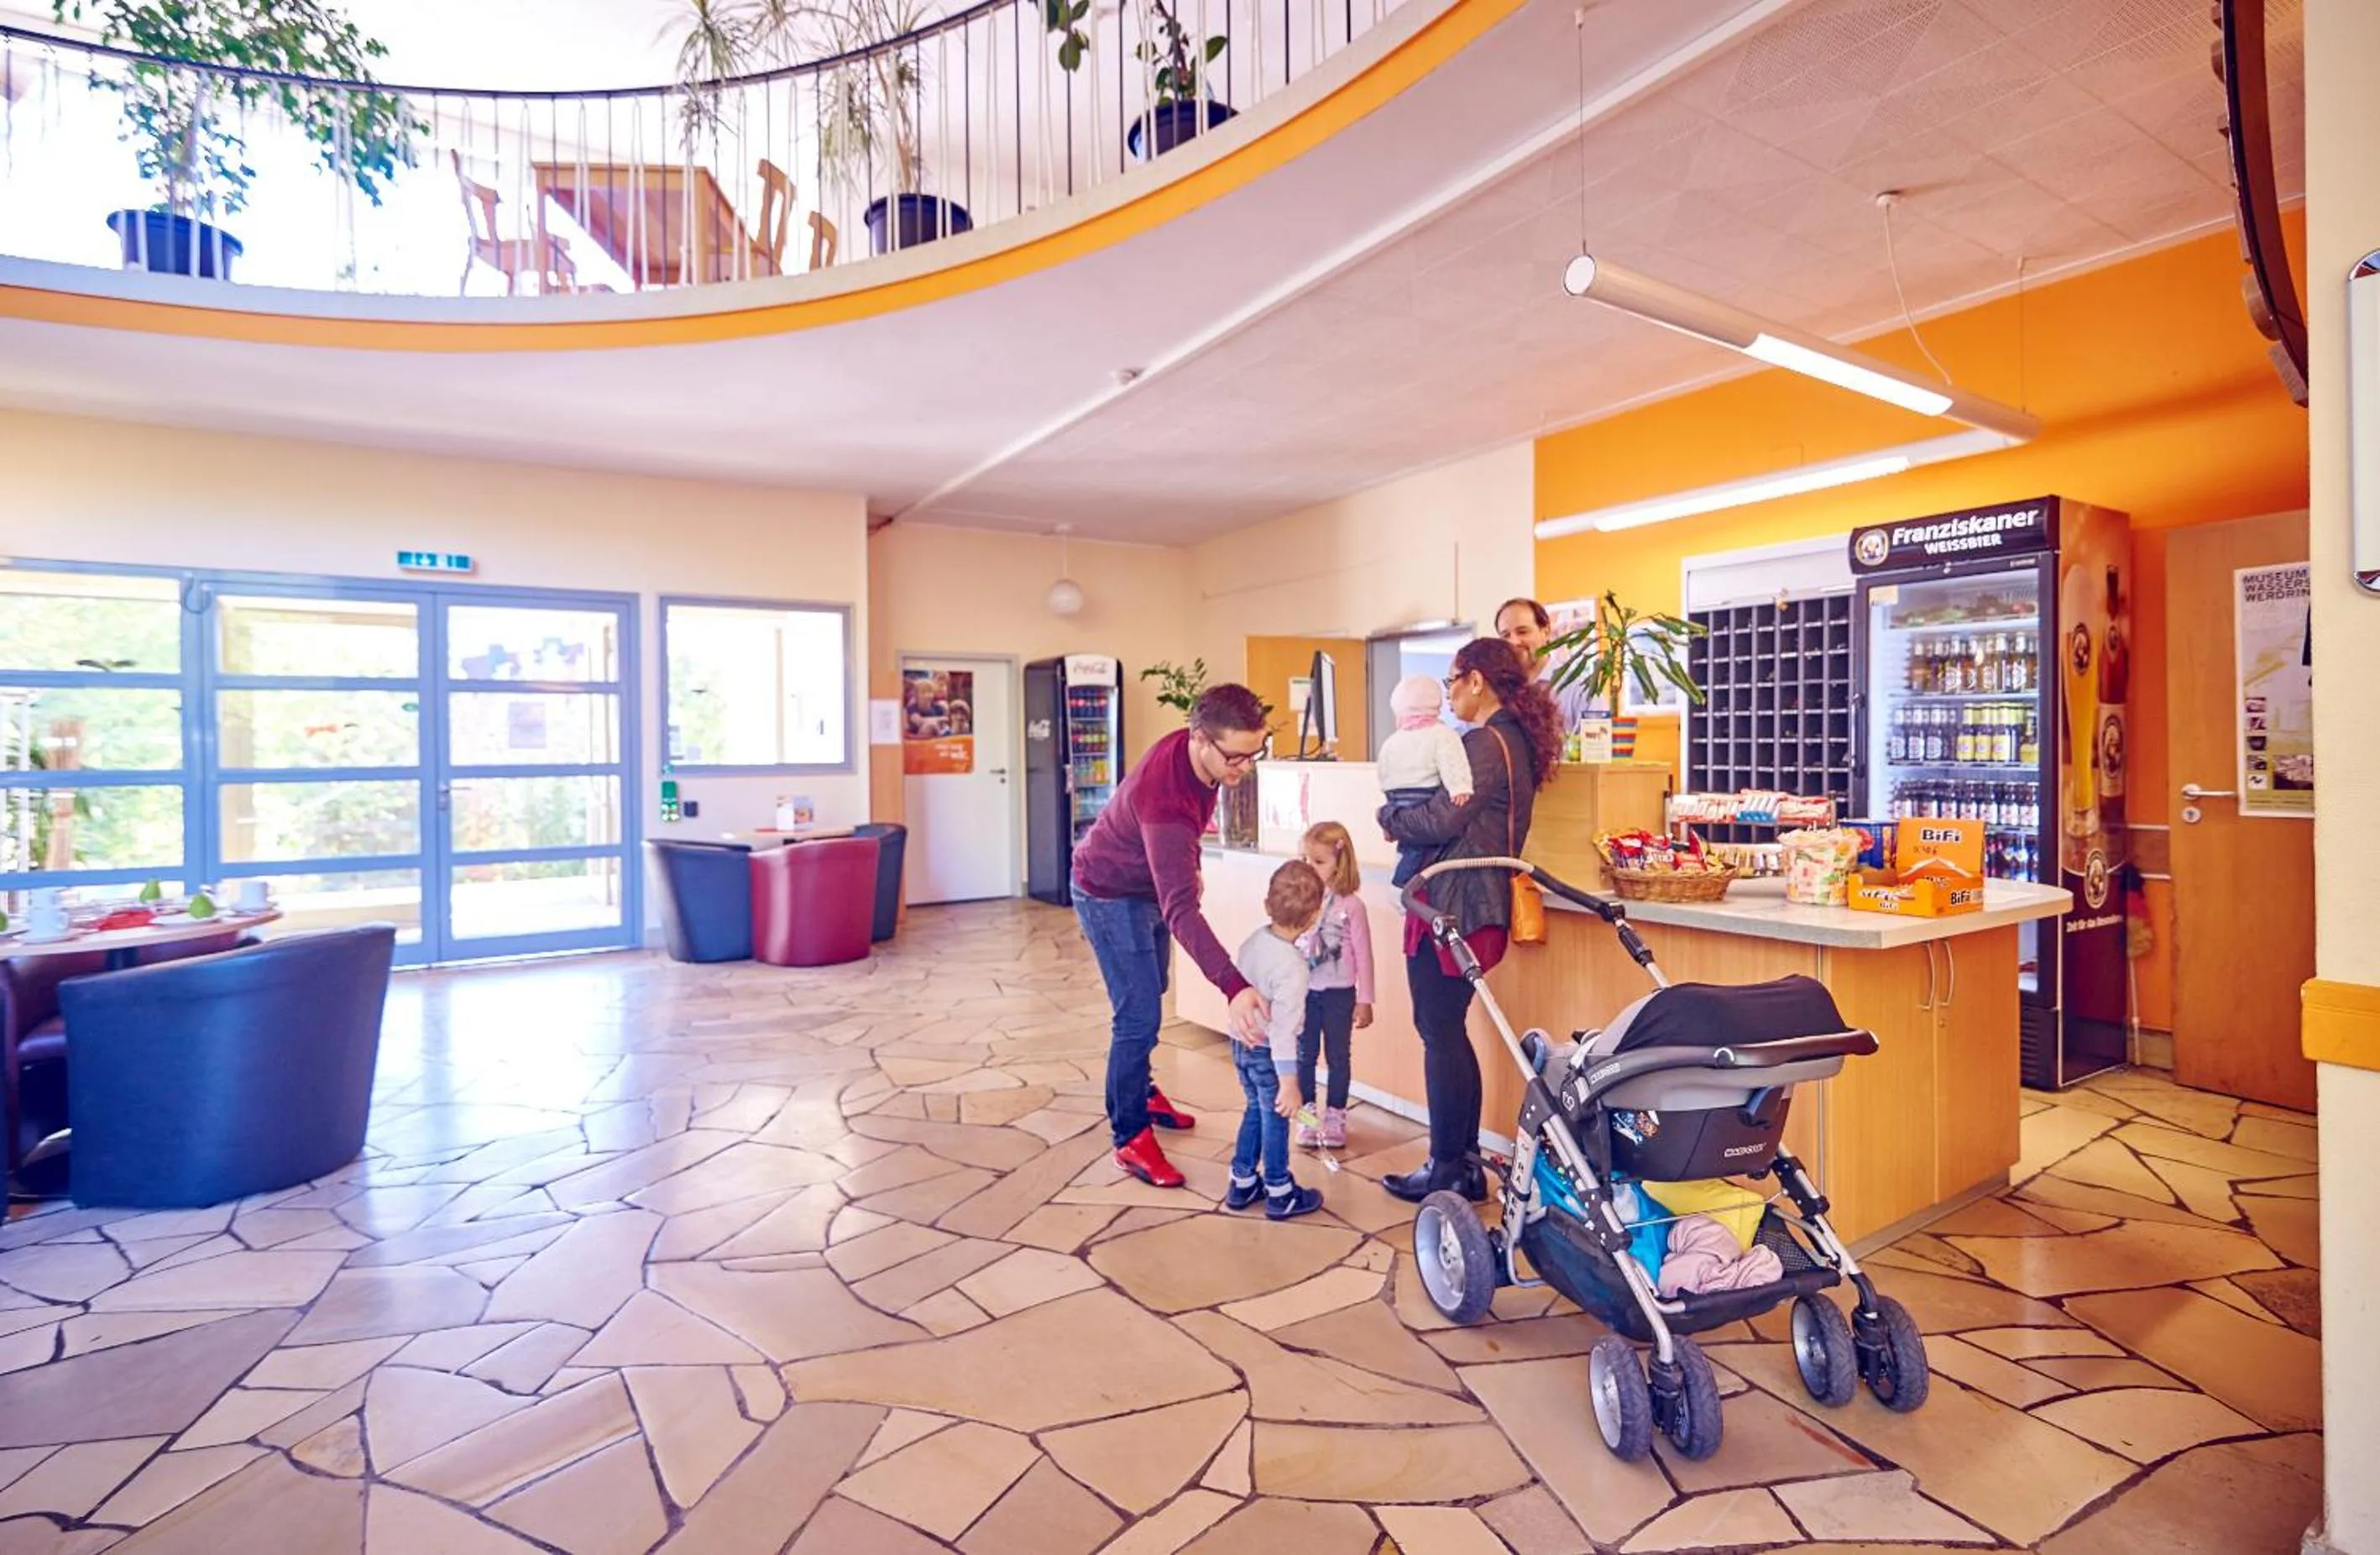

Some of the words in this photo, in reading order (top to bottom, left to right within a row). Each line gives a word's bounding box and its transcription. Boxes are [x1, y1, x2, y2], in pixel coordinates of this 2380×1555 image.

[1892, 509, 2039, 546] Franziskaner
[1923, 533, 2002, 555] WEISSBIER
[2242, 569, 2307, 584] MUSEUM
[1922, 828, 1961, 843] BiFi
